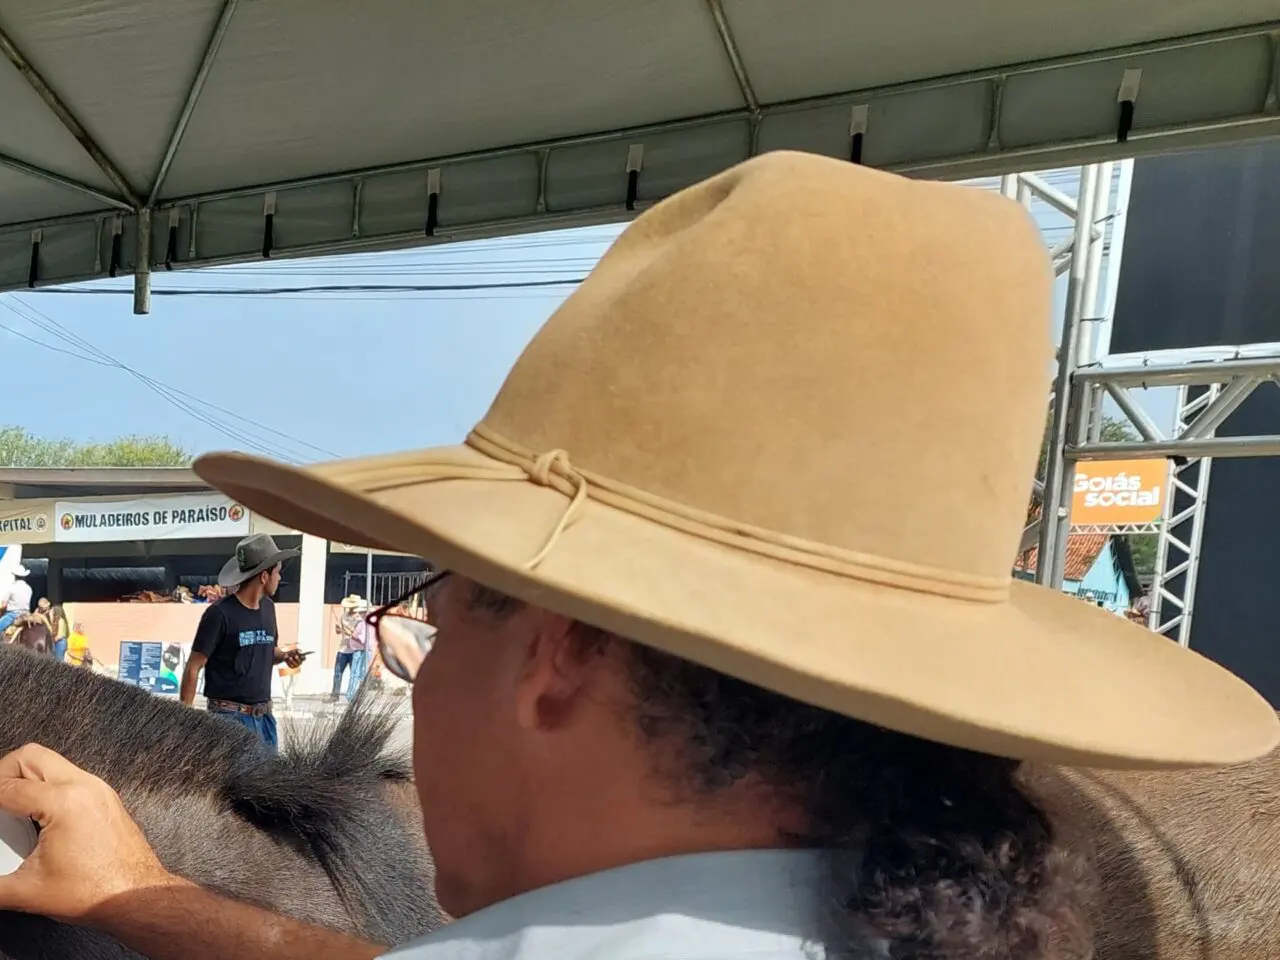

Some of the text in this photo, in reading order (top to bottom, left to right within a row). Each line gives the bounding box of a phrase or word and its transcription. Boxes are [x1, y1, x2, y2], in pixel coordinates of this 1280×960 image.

[74, 505, 227, 528] MULADEIROS DE PARAÍSO
